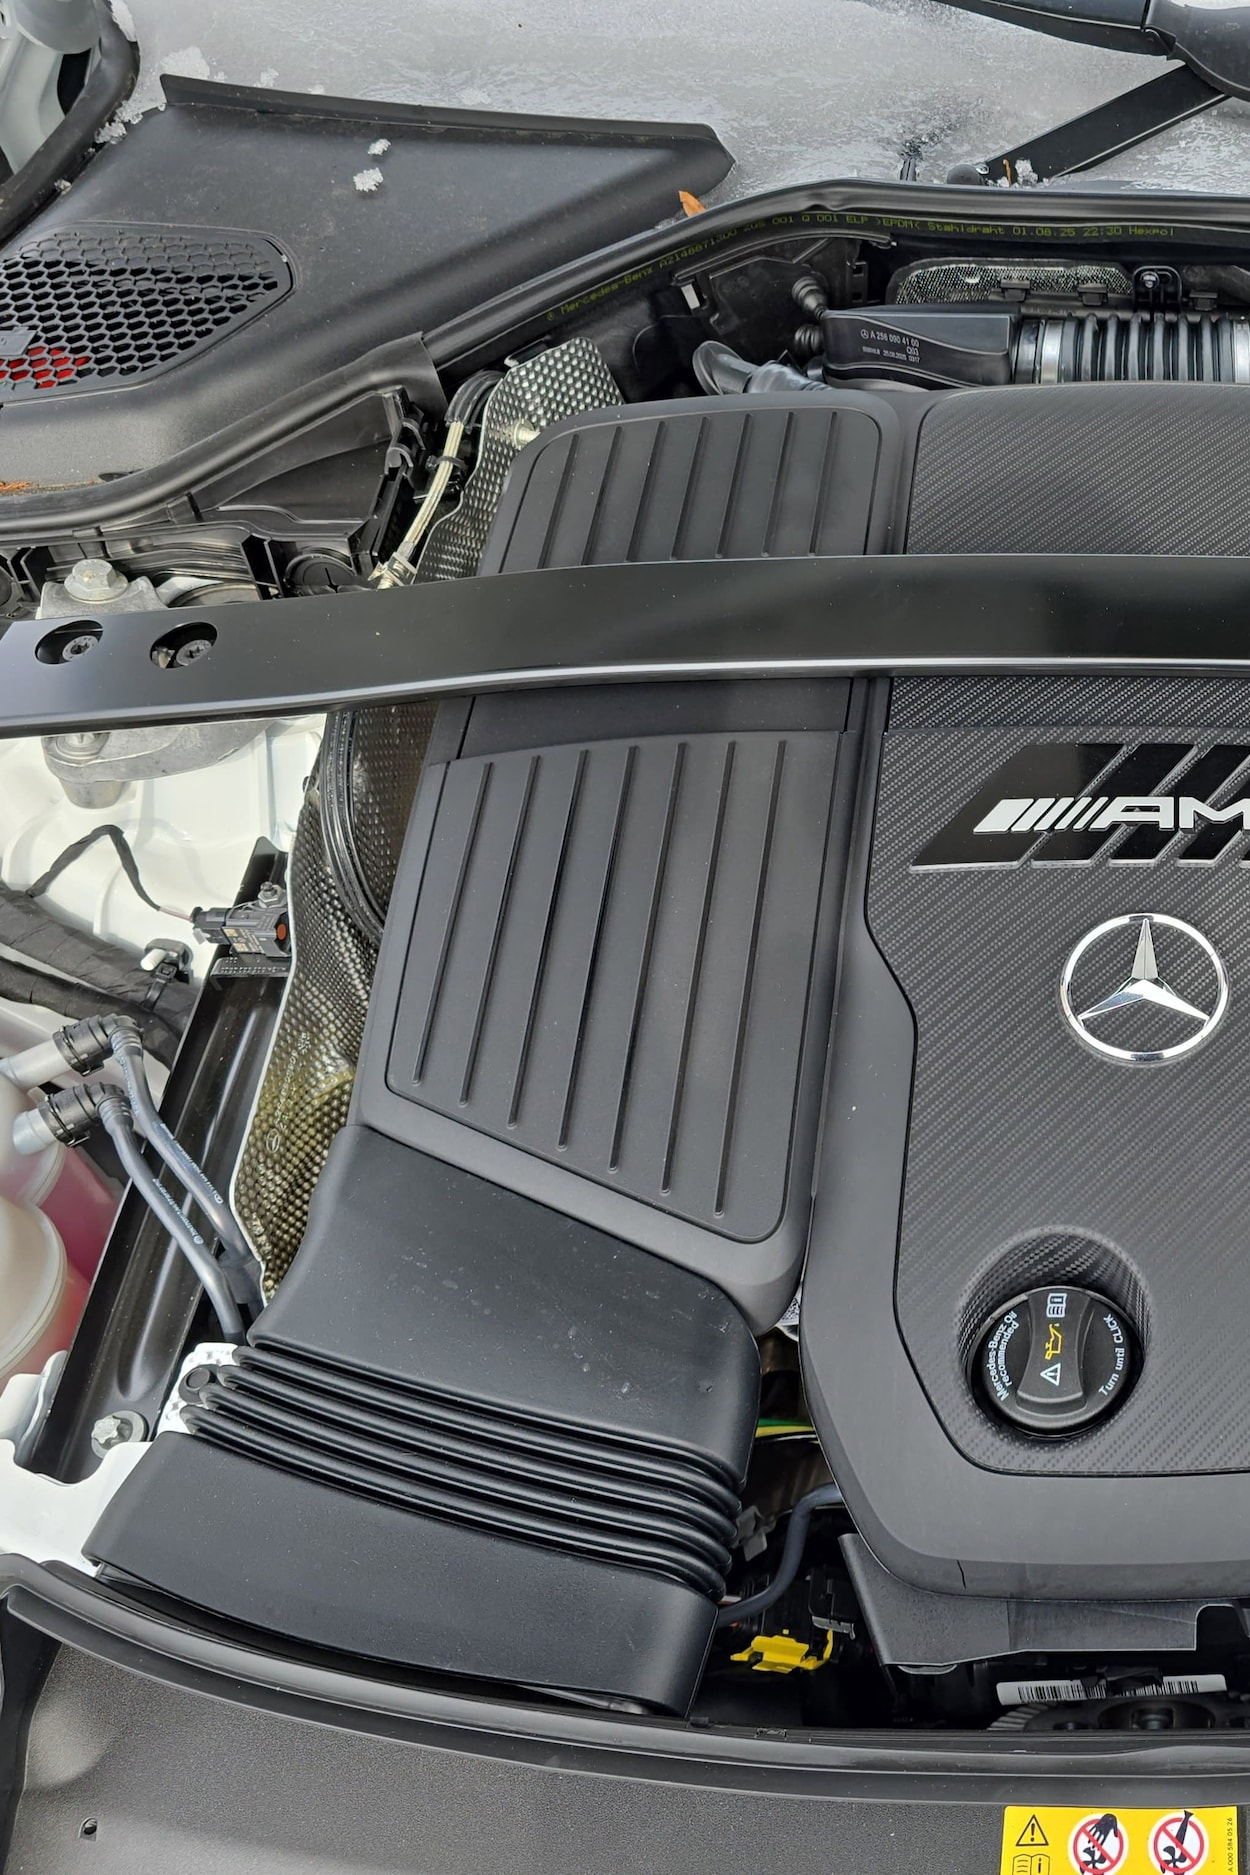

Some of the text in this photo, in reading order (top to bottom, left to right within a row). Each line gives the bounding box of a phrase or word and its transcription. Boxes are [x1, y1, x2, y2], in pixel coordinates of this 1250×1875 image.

[560, 266, 653, 316] Mercedes-Benz
[816, 214, 839, 223] 001
[846, 215, 869, 224] ELP
[928, 222, 1005, 235] Stahldraht
[1083, 226, 1122, 237] 22:30
[1129, 226, 1175, 237] Hexpol
[986, 1310, 1018, 1401] Mercedes-Benz Oil
[998, 1320, 1020, 1387] recommended
[1098, 1313, 1125, 1396] Turn until CLICK
[1226, 1817, 1233, 1826] 26
[1226, 1827, 1233, 1837] 05
